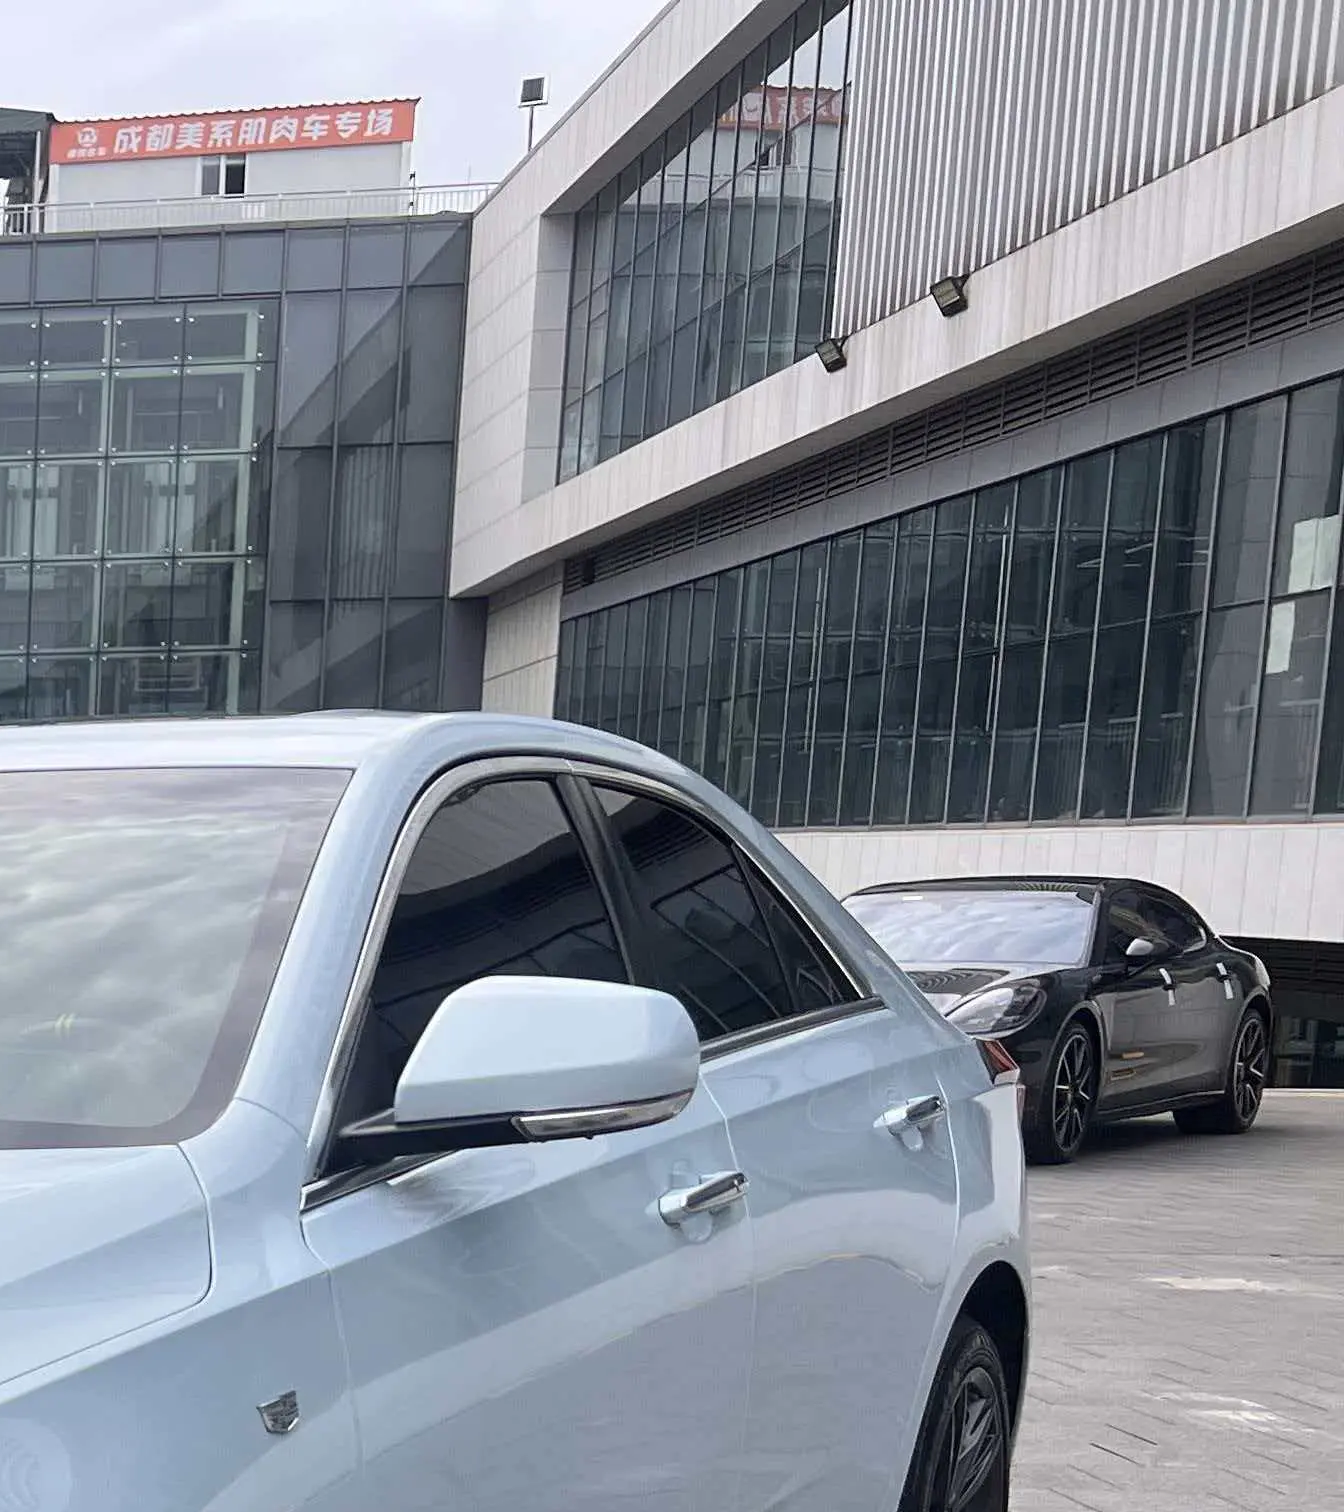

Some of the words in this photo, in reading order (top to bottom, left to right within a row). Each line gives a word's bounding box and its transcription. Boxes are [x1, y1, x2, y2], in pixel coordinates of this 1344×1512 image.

[114, 108, 394, 153] 成都美系肌肉车专场
